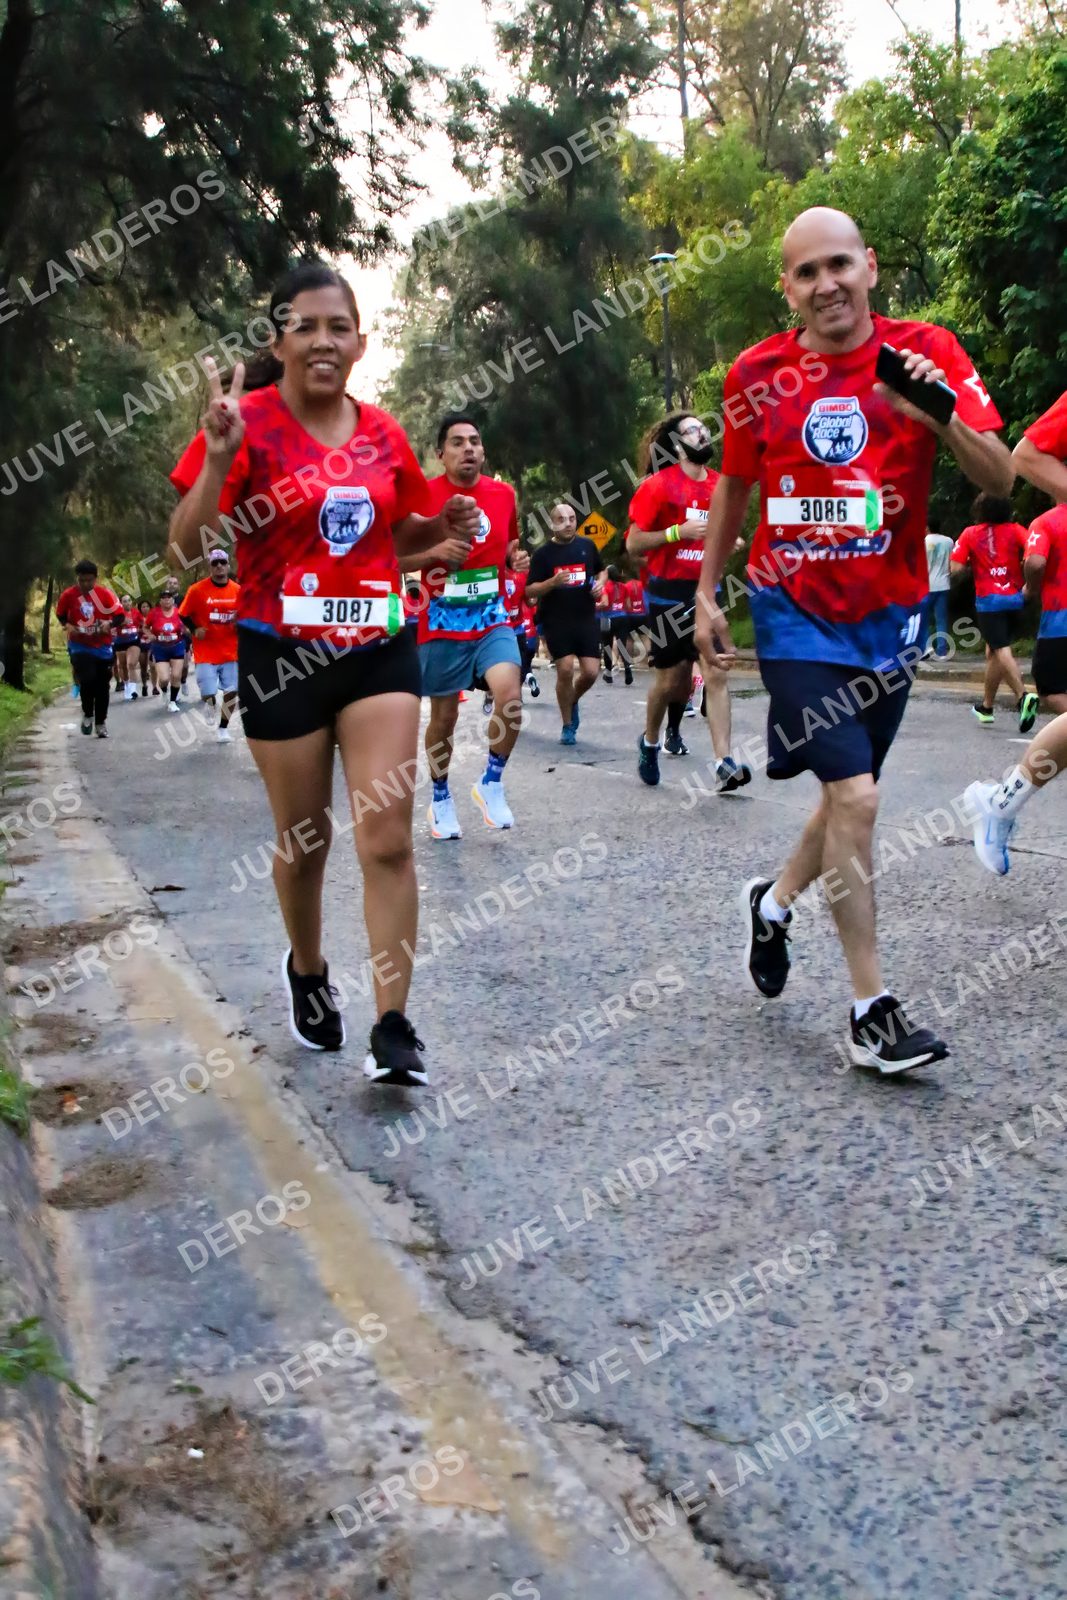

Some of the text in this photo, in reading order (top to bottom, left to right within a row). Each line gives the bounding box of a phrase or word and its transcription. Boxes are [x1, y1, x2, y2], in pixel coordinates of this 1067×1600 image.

[819, 403, 852, 412] BIMBO
[819, 415, 852, 428] Global
[813, 427, 840, 439] Race
[800, 498, 847, 523] 3086
[467, 583, 479, 594] 45
[323, 599, 373, 623] 3087
